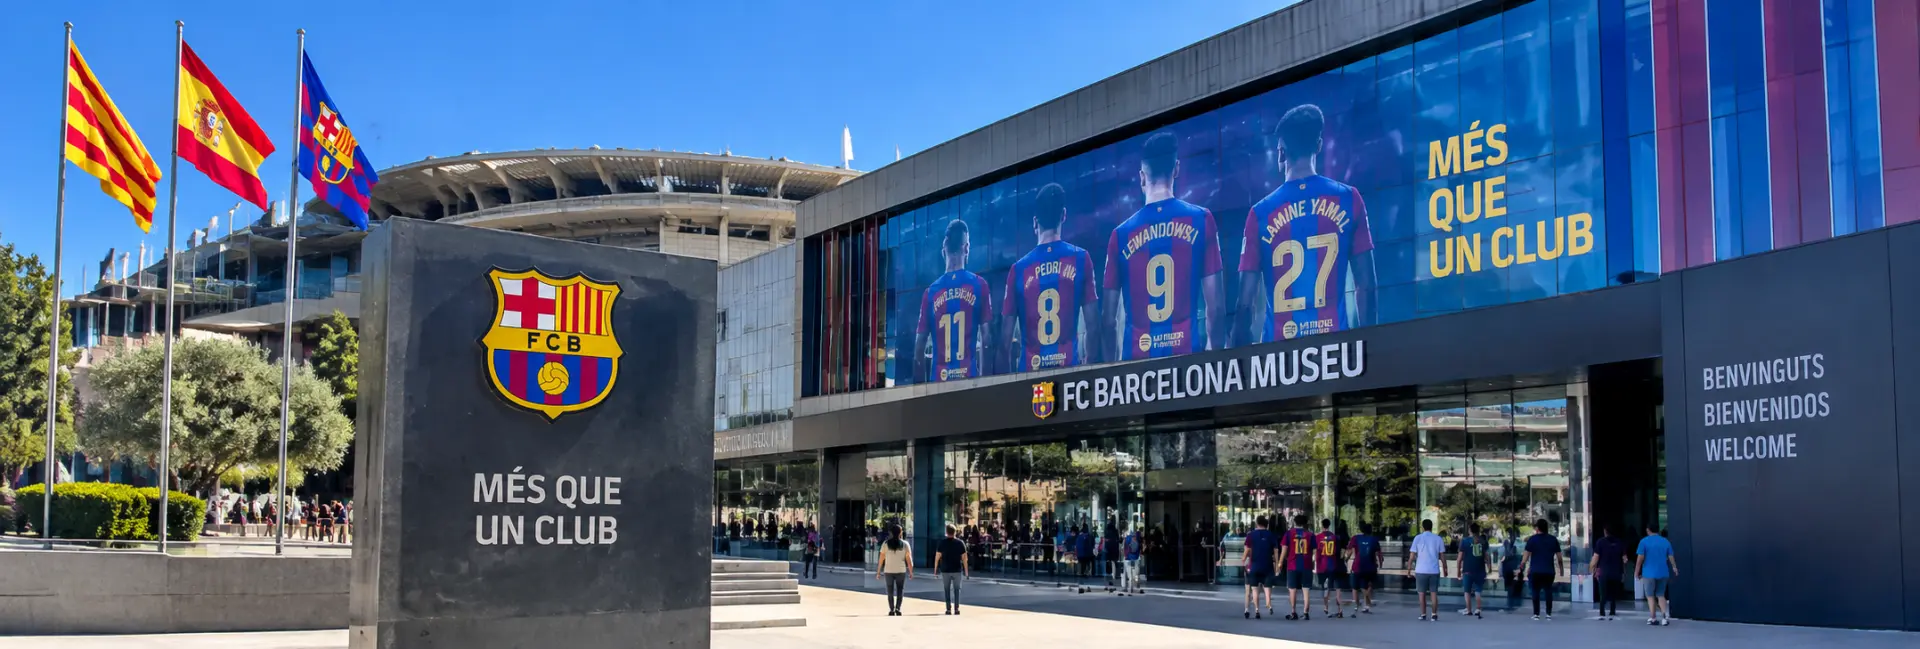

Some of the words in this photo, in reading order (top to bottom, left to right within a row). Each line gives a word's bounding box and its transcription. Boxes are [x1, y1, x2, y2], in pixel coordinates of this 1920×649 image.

[1427, 119, 1509, 180] MÉS
[1261, 200, 1307, 245] LAMINE
[1310, 198, 1351, 234] YAMAL
[1428, 175, 1507, 233] QUE
[1429, 232, 1482, 278] UN
[1490, 211, 1594, 269] CLUB
[1034, 260, 1062, 280] PEDRI
[1146, 253, 1175, 323] 9
[1271, 232, 1339, 313] 27
[938, 310, 966, 363] 11
[1037, 287, 1061, 346] 8
[527, 332, 581, 352] FCB
[1063, 380, 1090, 412] FC
[1094, 358, 1244, 408] BARCELONA
[1249, 340, 1364, 389] MUSEU
[1702, 352, 1825, 391] BENVINGUTS
[1703, 391, 1830, 427] BIENVENIDOS
[1705, 433, 1798, 462] WELCOME
[473, 466, 546, 504] MÉS
[555, 475, 622, 509] QUE
[475, 515, 525, 545] UN
[535, 514, 618, 546] CLUB
